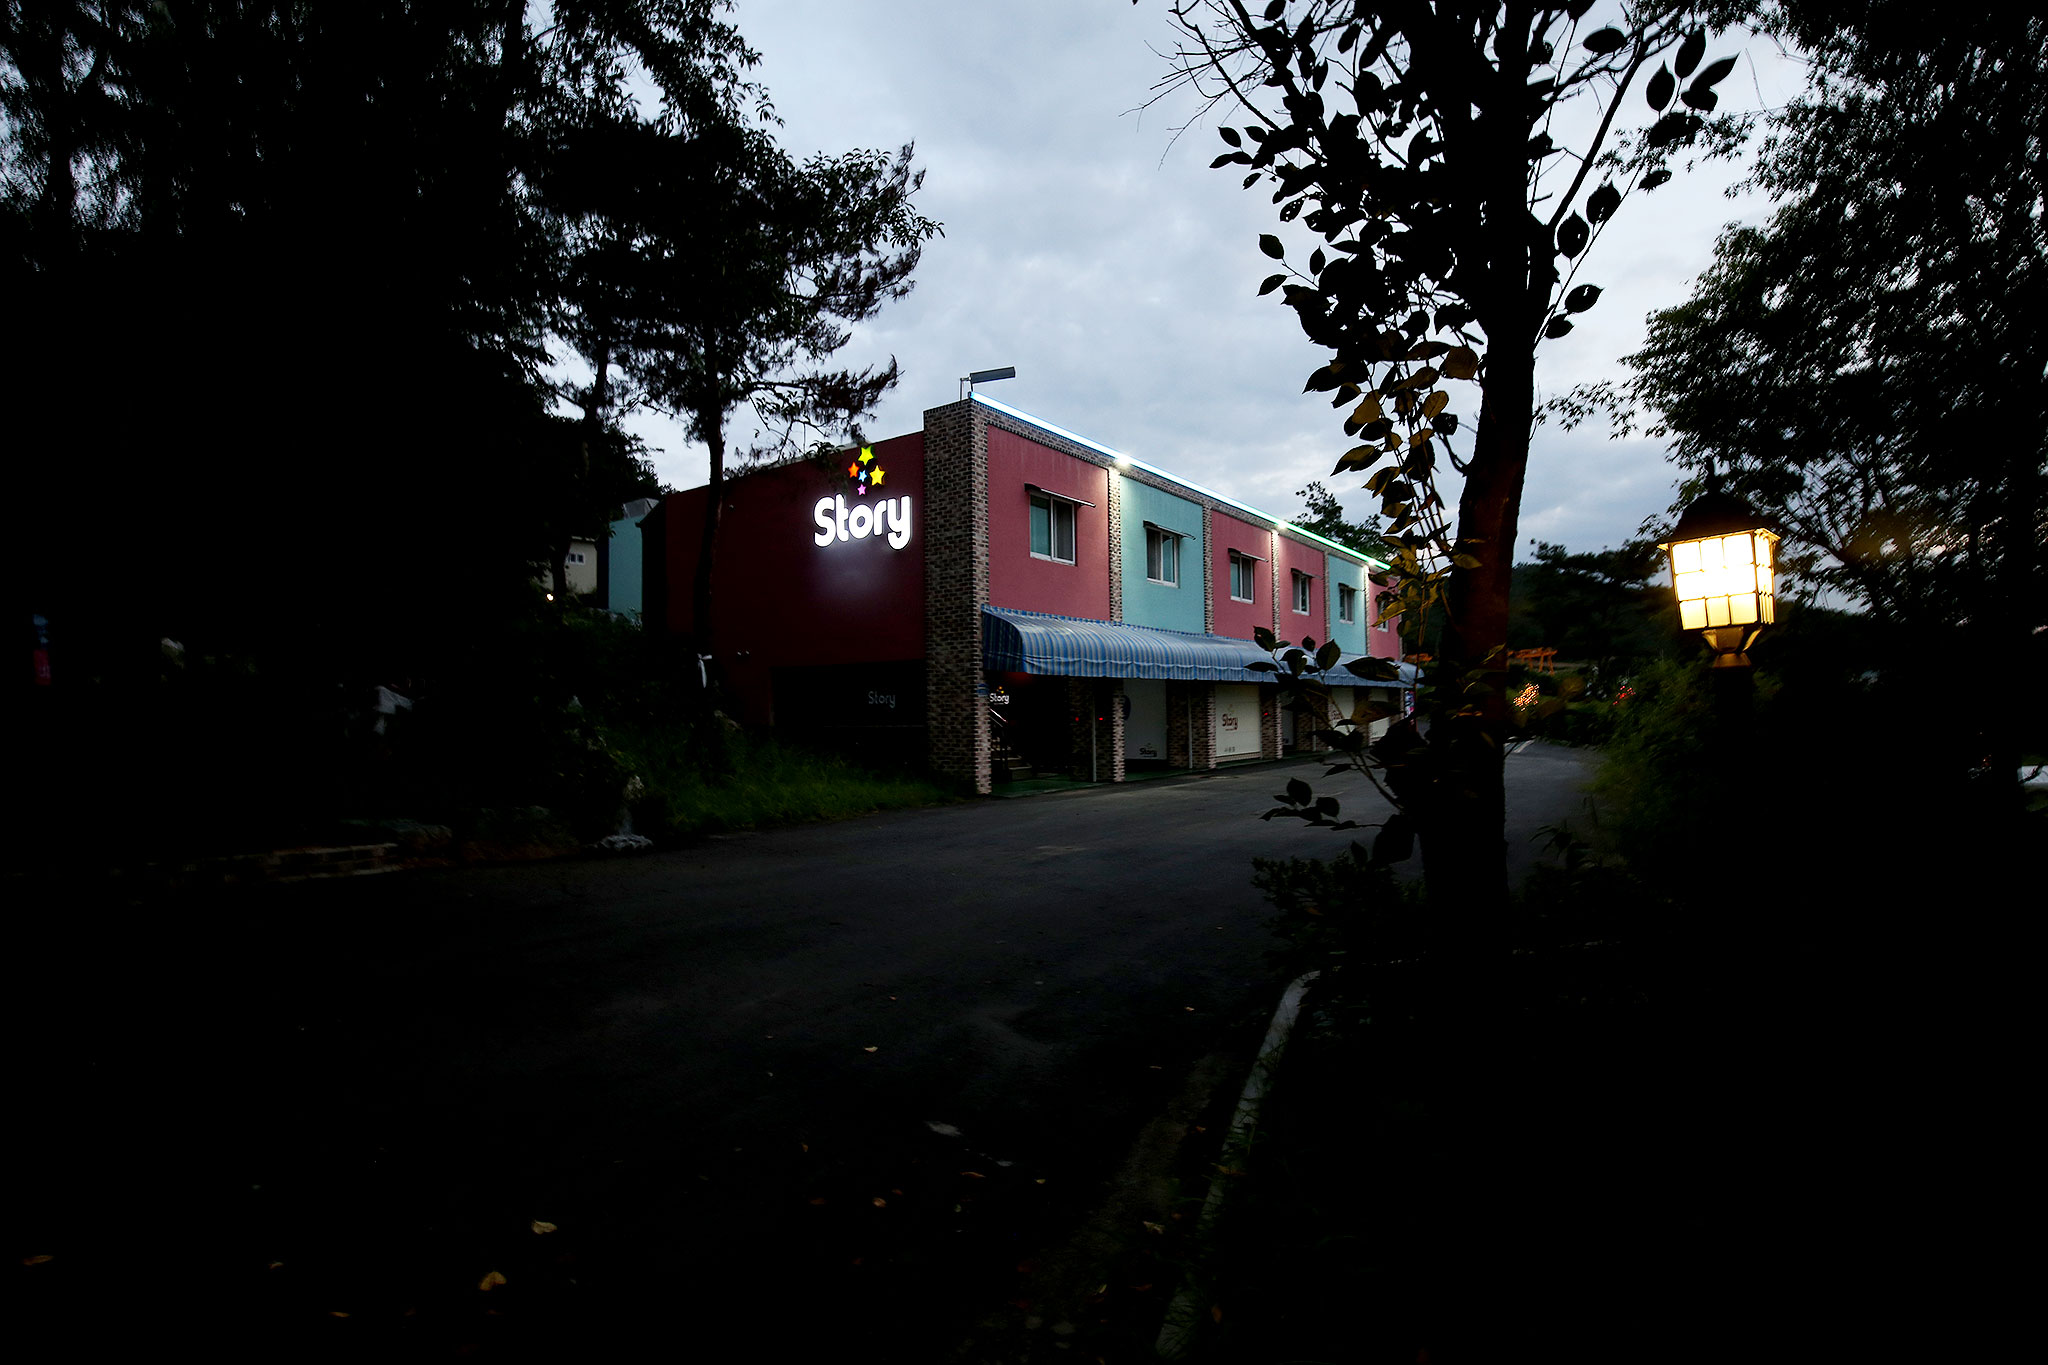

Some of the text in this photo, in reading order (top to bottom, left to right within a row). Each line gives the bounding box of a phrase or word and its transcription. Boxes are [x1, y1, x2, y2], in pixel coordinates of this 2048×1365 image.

[813, 493, 912, 550] Story
[868, 690, 896, 708] Story
[989, 695, 1010, 705] Story
